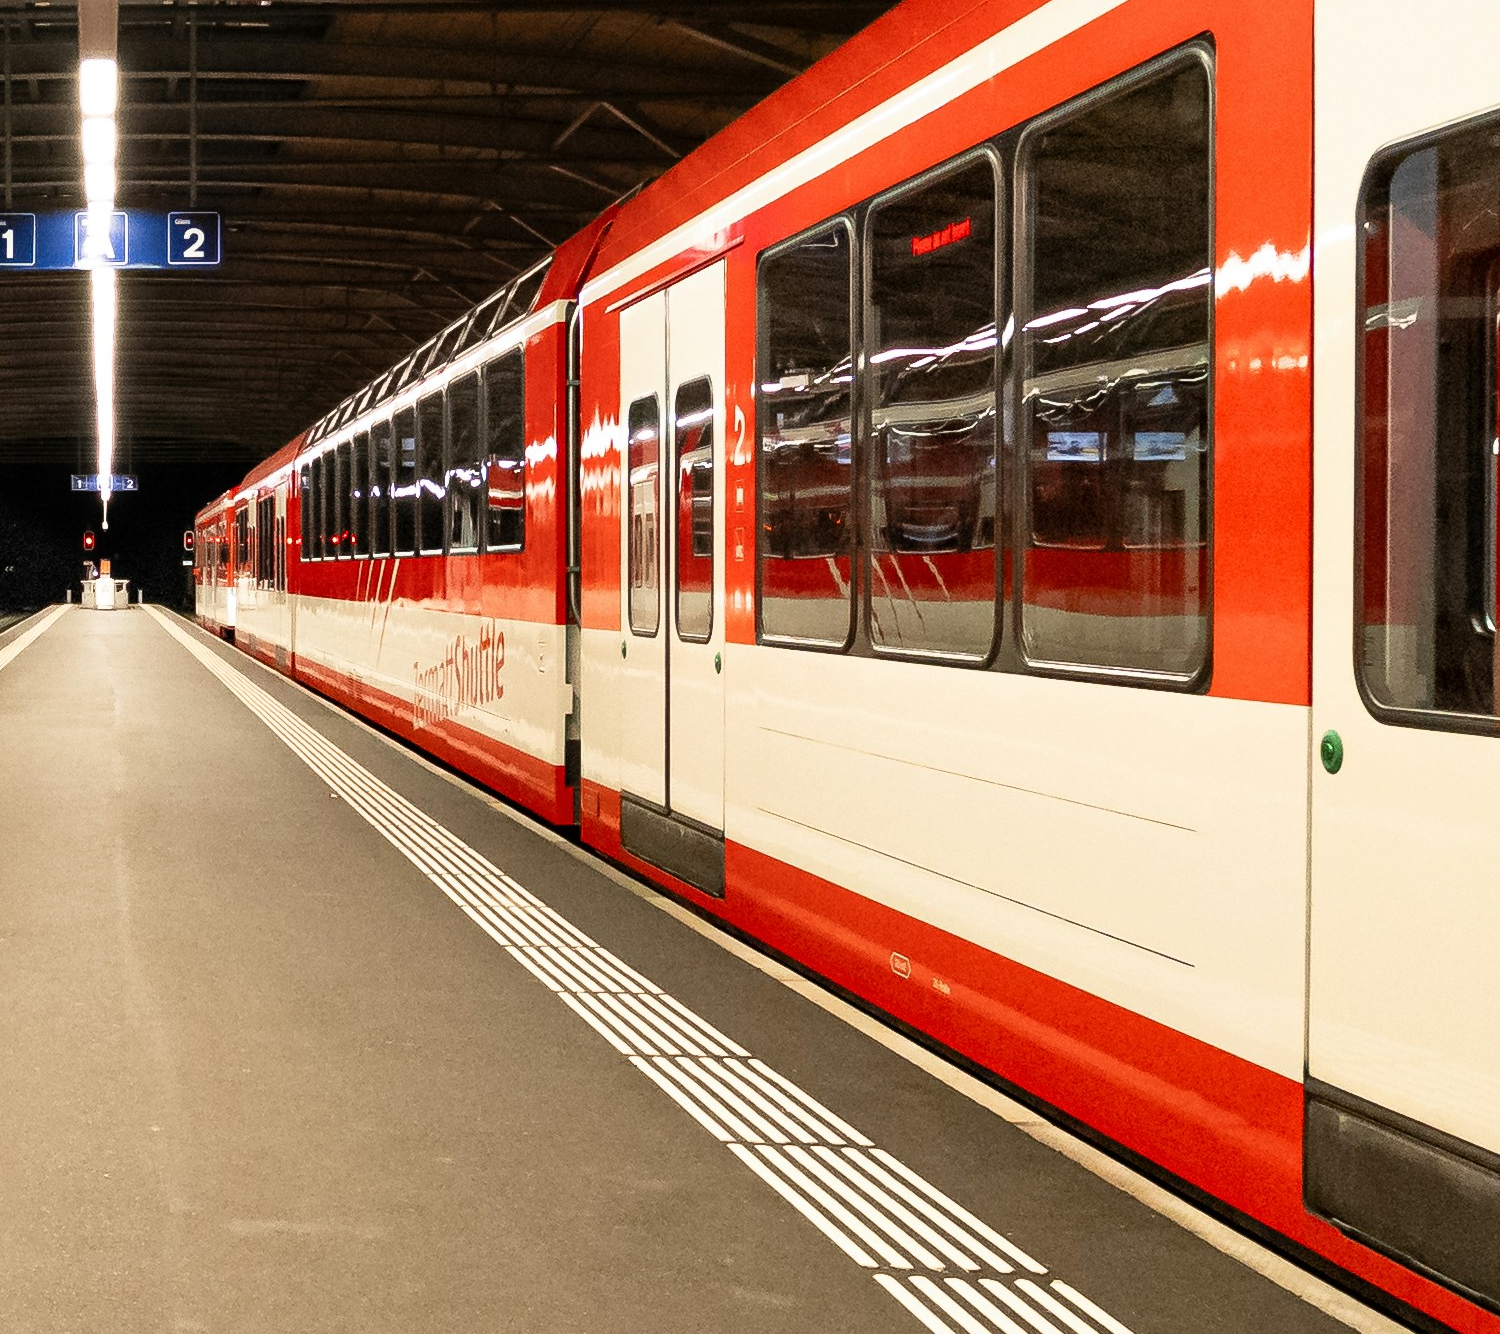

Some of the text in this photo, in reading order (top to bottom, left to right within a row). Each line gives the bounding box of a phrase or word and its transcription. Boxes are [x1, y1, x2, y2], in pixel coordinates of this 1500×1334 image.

[2, 229, 14, 259] 1
[183, 228, 205, 258] 2
[734, 405, 746, 465] 2
[77, 479, 82, 489] 1
[126, 479, 134, 489] 2
